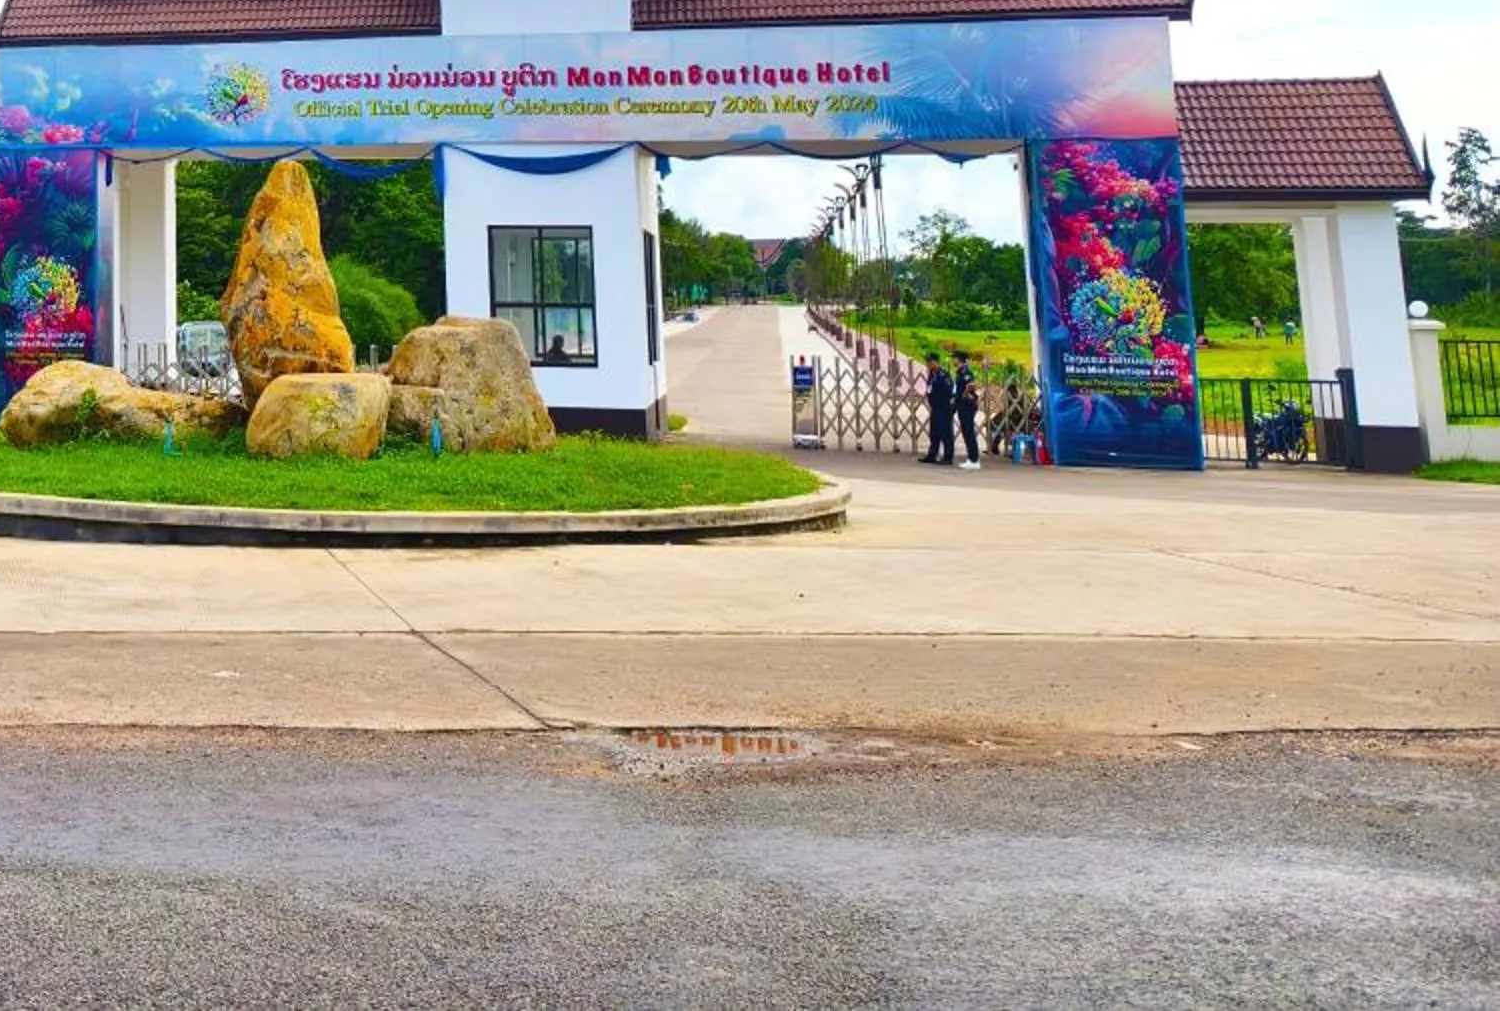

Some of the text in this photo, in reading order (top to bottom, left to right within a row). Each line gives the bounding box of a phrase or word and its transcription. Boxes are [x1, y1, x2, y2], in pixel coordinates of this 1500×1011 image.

[815, 61, 891, 85] Hotel
[294, 99, 362, 117] Official
[367, 98, 411, 116] Trial
[415, 99, 495, 119] Opening
[500, 96, 610, 115] Celebration
[722, 94, 768, 114] 20th
[771, 94, 820, 117] May
